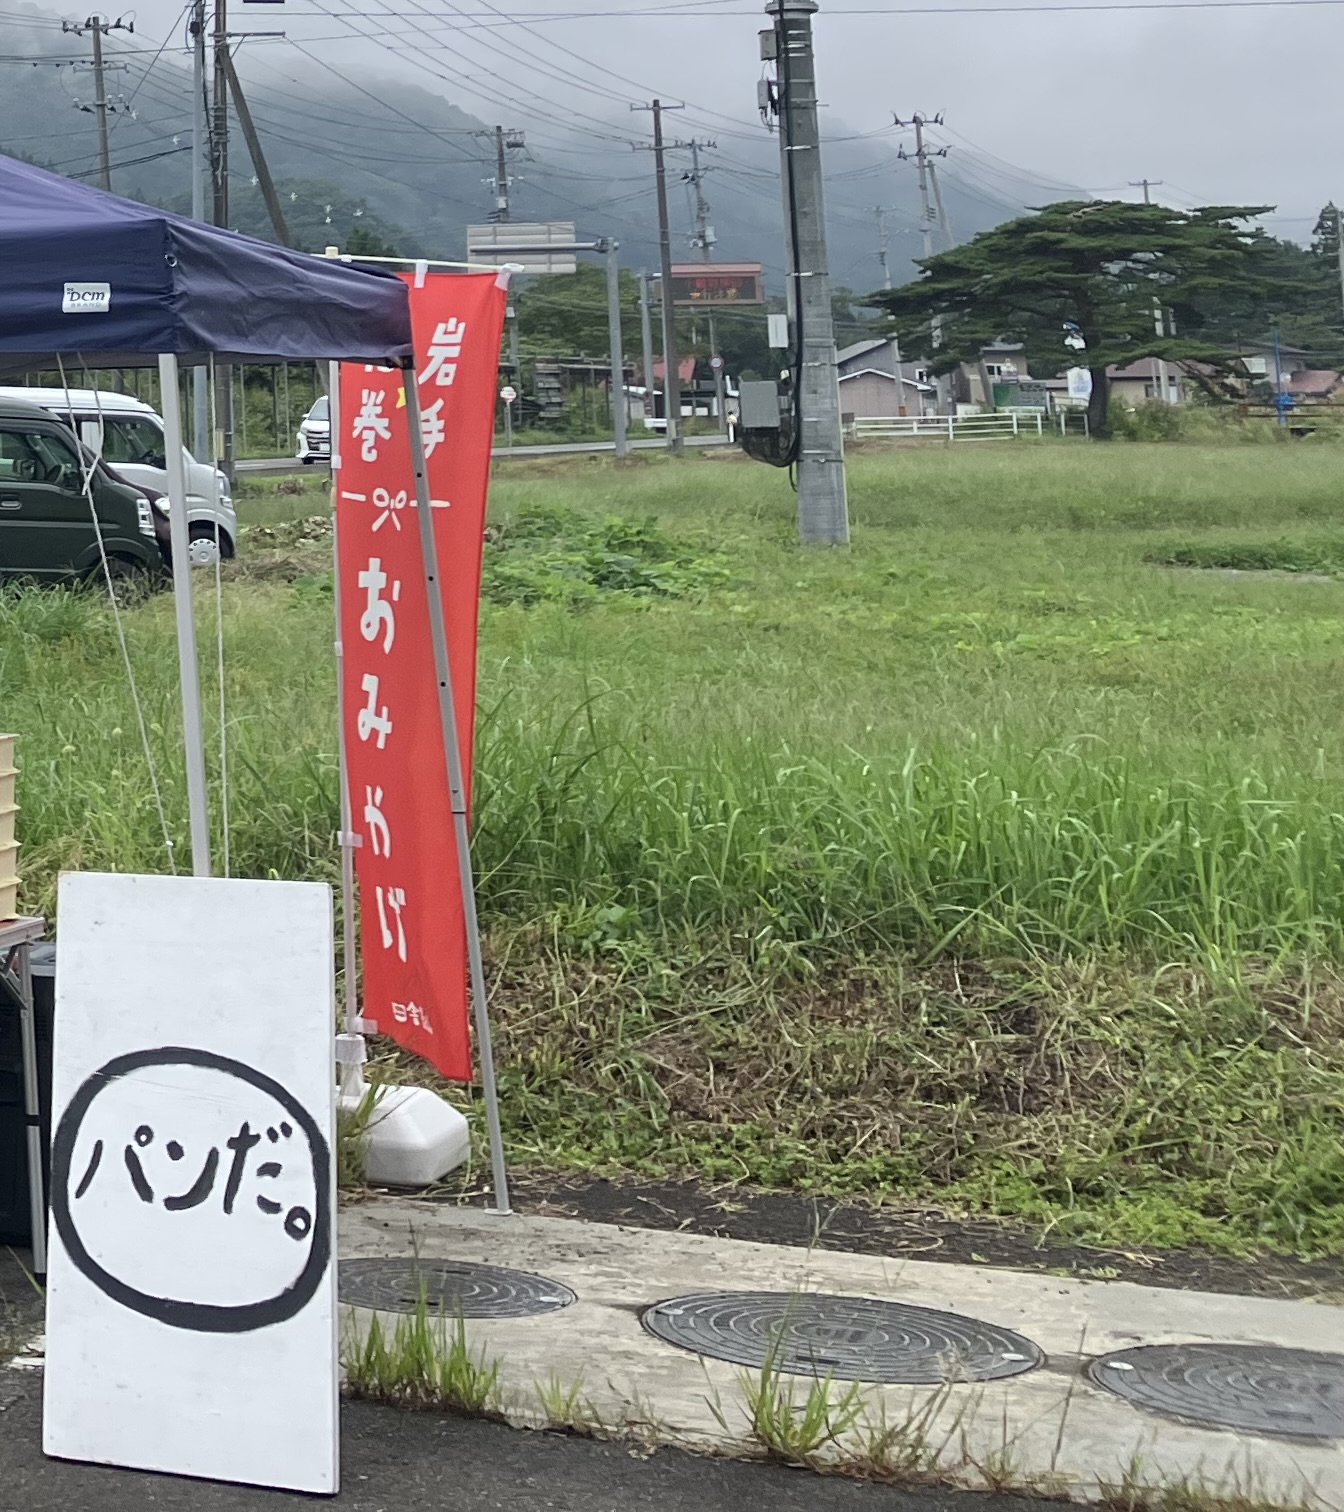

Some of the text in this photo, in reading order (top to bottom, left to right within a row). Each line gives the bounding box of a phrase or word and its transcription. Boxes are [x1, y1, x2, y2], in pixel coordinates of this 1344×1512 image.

[352, 364, 395, 463] 巻
[357, 557, 408, 963] おみやげ
[75, 1121, 311, 1241] パンだ。
